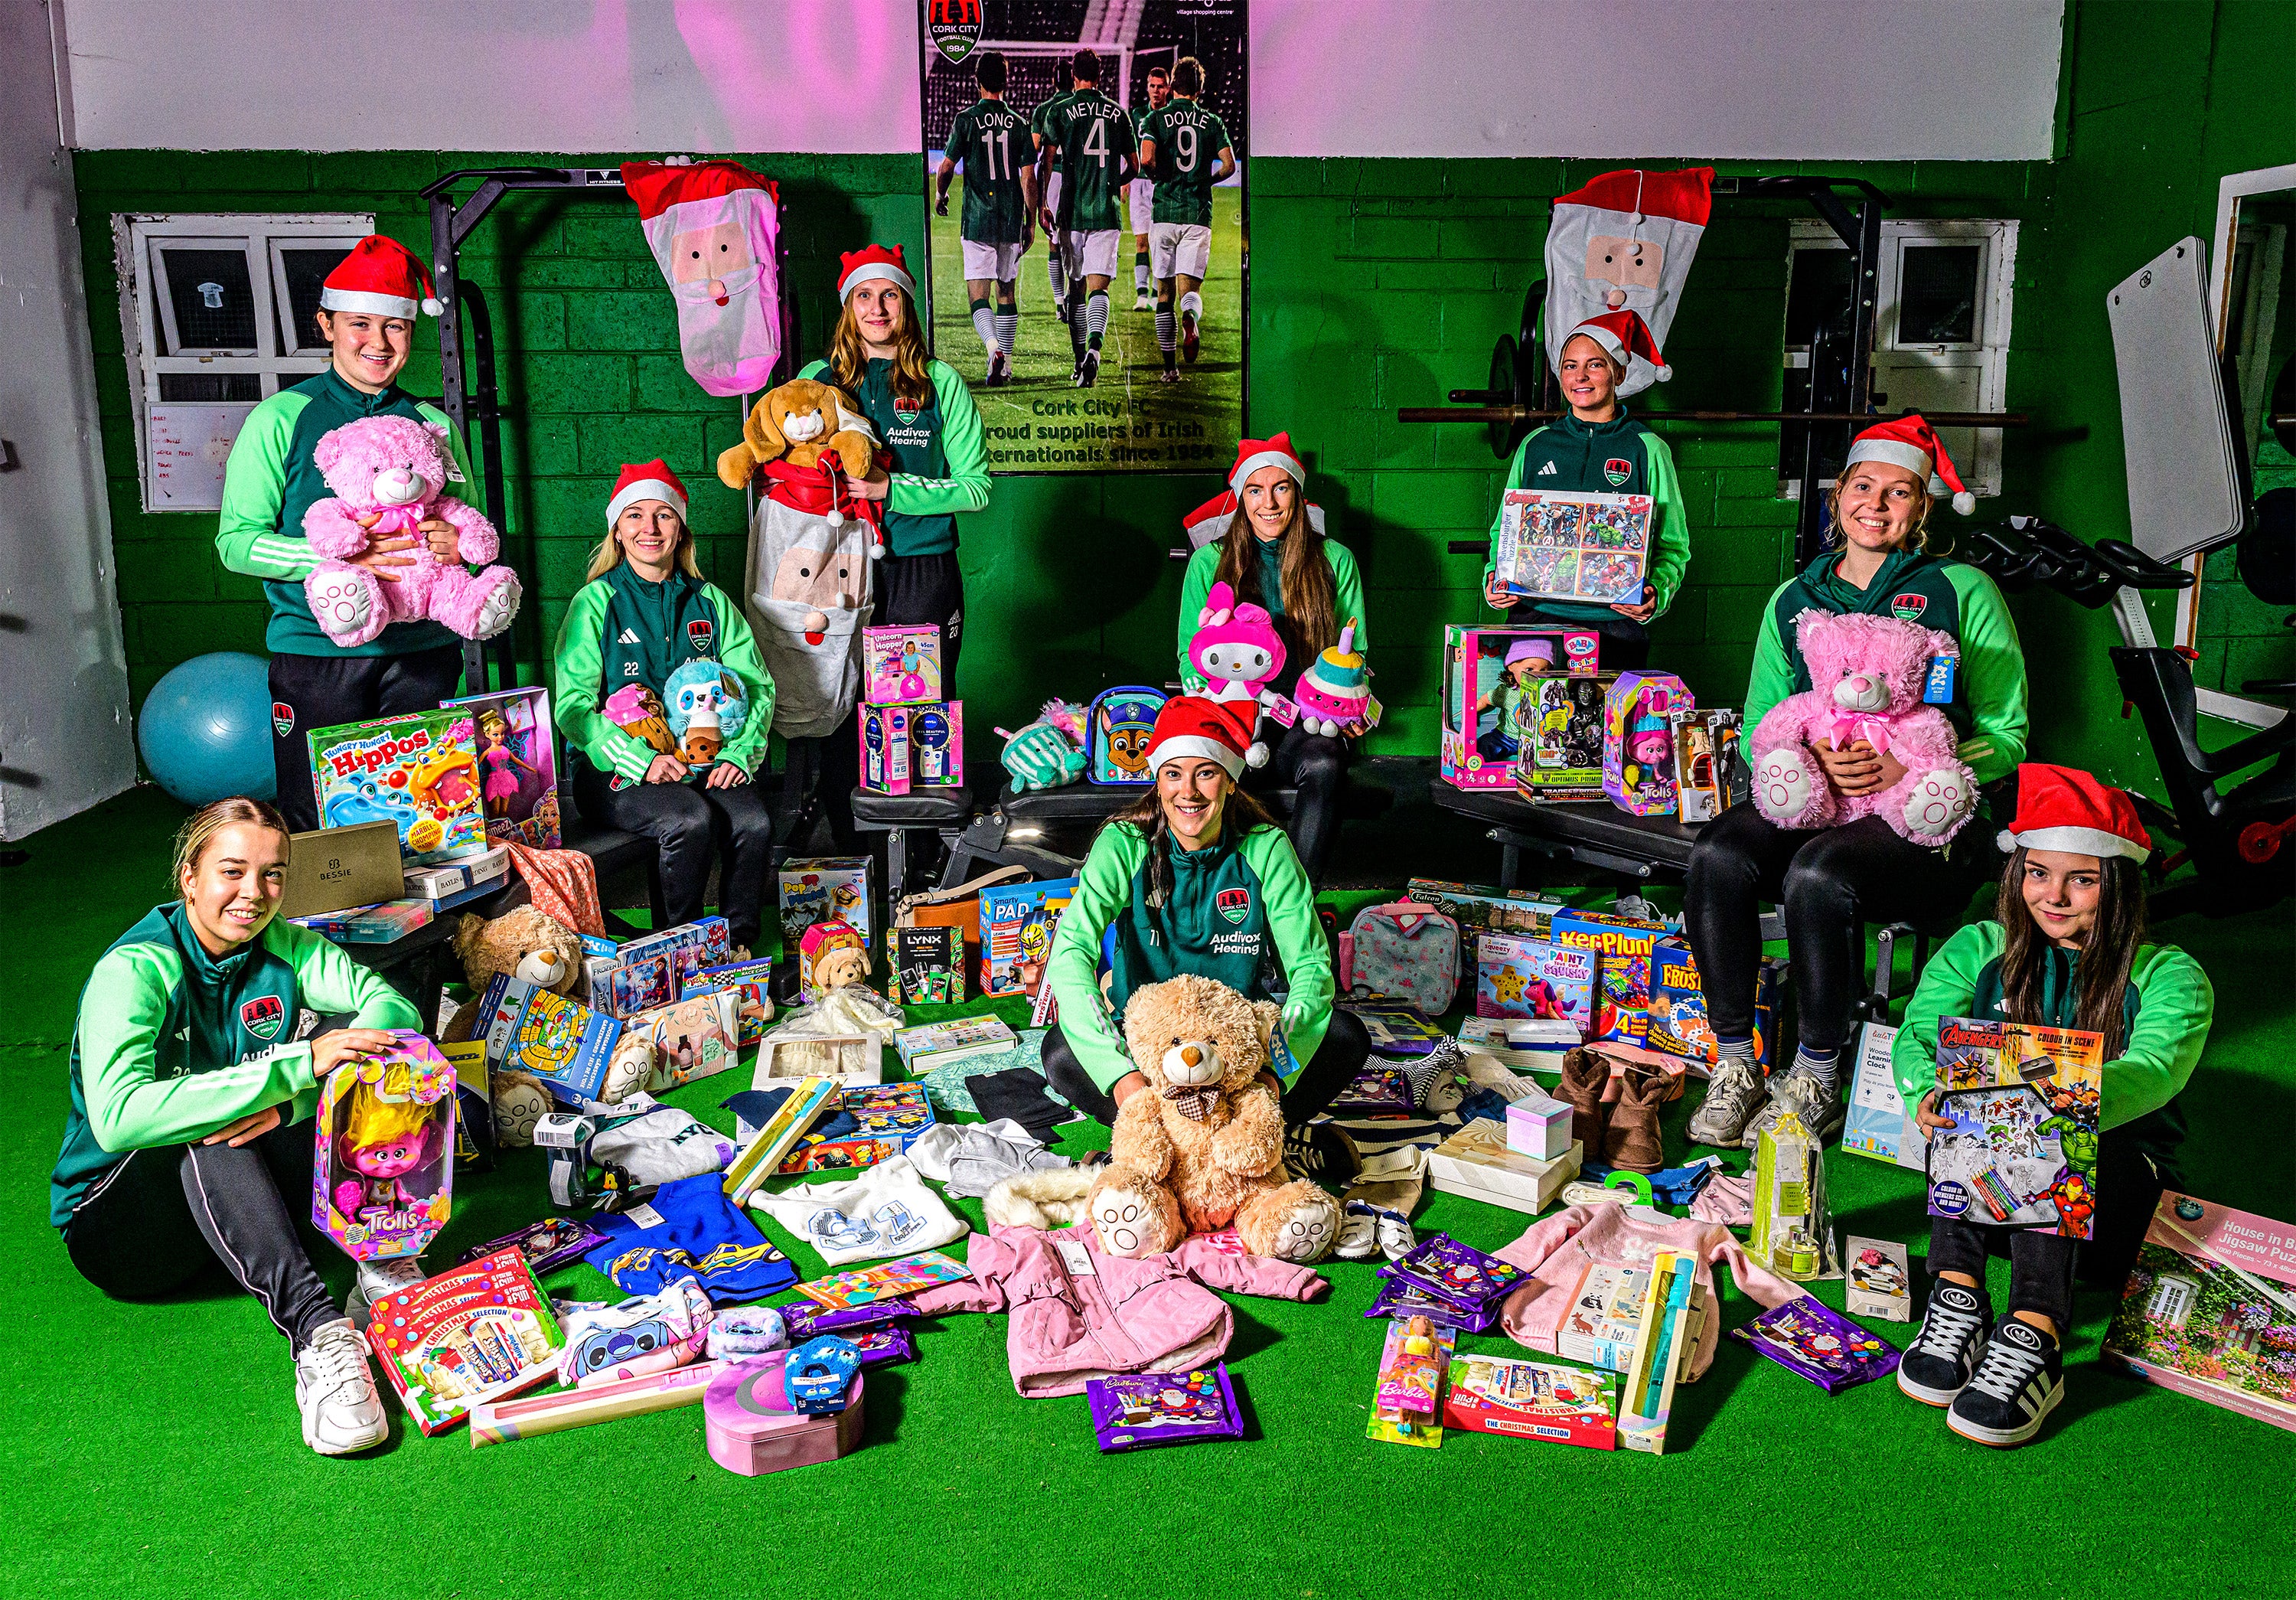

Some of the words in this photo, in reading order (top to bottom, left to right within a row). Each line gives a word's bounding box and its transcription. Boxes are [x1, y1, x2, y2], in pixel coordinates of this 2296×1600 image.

[937, 34, 961, 44] FOOTBALL
[961, 35, 975, 44] CLUB
[1065, 102, 1121, 123] MEYLER
[1163, 111, 1210, 130] DOYLE
[974, 113, 1014, 129] LONG
[1083, 118, 1110, 168] 4
[1175, 125, 1197, 173] 9
[981, 129, 1010, 181] 11
[1032, 399, 1077, 416] Cork
[1083, 399, 1121, 419] City
[1127, 400, 1151, 416] FC
[886, 427, 931, 437] Audivox
[986, 423, 1031, 440] roud
[1036, 422, 1127, 442] suppliers
[1132, 421, 1153, 439] of
[1158, 421, 1204, 438] Irish
[889, 436, 928, 448] Hearing
[987, 445, 1104, 463] ternationals
[1110, 445, 1160, 461] since
[1506, 539, 1517, 562] Puzzle
[874, 633, 903, 643] Unicorn
[949, 625, 959, 639] 23
[876, 641, 905, 651] Hopper
[1568, 639, 1595, 649] BABY
[624, 661, 640, 677] 22
[1570, 657, 1597, 668] Brother
[325, 742, 358, 759] HUNGRY
[358, 733, 390, 749] HUNGRY
[1605, 769, 1619, 784] Trolls
[1639, 783, 1671, 798] Trolls
[411, 824, 435, 839] MARBLE-
[412, 828, 442, 845] CHOMPING
[320, 868, 352, 881] BESSIE
[441, 877, 459, 889] BAYLIS
[783, 882, 807, 894] Pop
[1416, 893, 1440, 903] Falcon
[994, 903, 1029, 920] PAD
[980, 914, 990, 929] PAD
[907, 936, 941, 945] LYNX
[1209, 931, 1261, 945] Audivox
[645, 945, 667, 957] Bumper
[667, 941, 682, 952] Puzzle
[683, 937, 696, 947] Pack
[1213, 943, 1260, 955] Hearing
[1485, 944, 1511, 953] squeezy
[1550, 950, 1585, 965] PAINT
[593, 963, 616, 976] FROZEN
[742, 962, 769, 972] Numbers
[1544, 963, 1590, 979] SQUISHY
[1037, 984, 1052, 1024] MYSTERIO
[247, 1017, 266, 1027] CORK
[266, 1012, 282, 1021] CITY
[1616, 1014, 1629, 1034] 4
[1653, 1023, 1662, 1033] The
[592, 1019, 608, 1055] GANZENBORD
[599, 1023, 615, 1055] GOOSEGAME
[1649, 1029, 1668, 1044] chasing
[1668, 1038, 1681, 1050] game
[1940, 1024, 2006, 1049] AVENGERS
[2037, 1033, 2063, 1044] COLOUR
[2063, 1036, 2073, 1045] IN
[2073, 1037, 2095, 1048] SCENE
[1648, 1037, 1664, 1049] drives
[1664, 1043, 1675, 1053] you
[584, 1066, 591, 1076] DE
[1867, 1060, 1886, 1069] Clock
[670, 1122, 715, 1146] NYC
[315, 1187, 328, 1213] Trolls
[1934, 1191, 1955, 1200] AVENGERS
[361, 1210, 418, 1235] Trolls
[2223, 1220, 2265, 1241] House
[2268, 1232, 2281, 1246] in
[2218, 1232, 2268, 1256] Jigsaw
[2215, 1246, 2232, 1256] 1000
[2232, 1250, 2255, 1263] Pieces
[471, 1308, 507, 1318] SELECTION
[1792, 1299, 1825, 1324] Cadbury
[426, 1311, 471, 1346] CHRISTMAS
[422, 1346, 432, 1358] THE
[483, 1336, 510, 1373] SMARTIES
[507, 1334, 524, 1359] Milkybar
[1104, 1378, 1145, 1389] Cadbury
[1381, 1382, 1429, 1399] Barbie
[2177, 1380, 2206, 1396] House
[1485, 1393, 1521, 1410] SELECTION
[1521, 1406, 1578, 1416] CHRISTMAS
[1486, 1419, 1499, 1429] THE
[1499, 1422, 1535, 1433] CHRISTMAS
[1536, 1427, 1570, 1438] SELECTION
